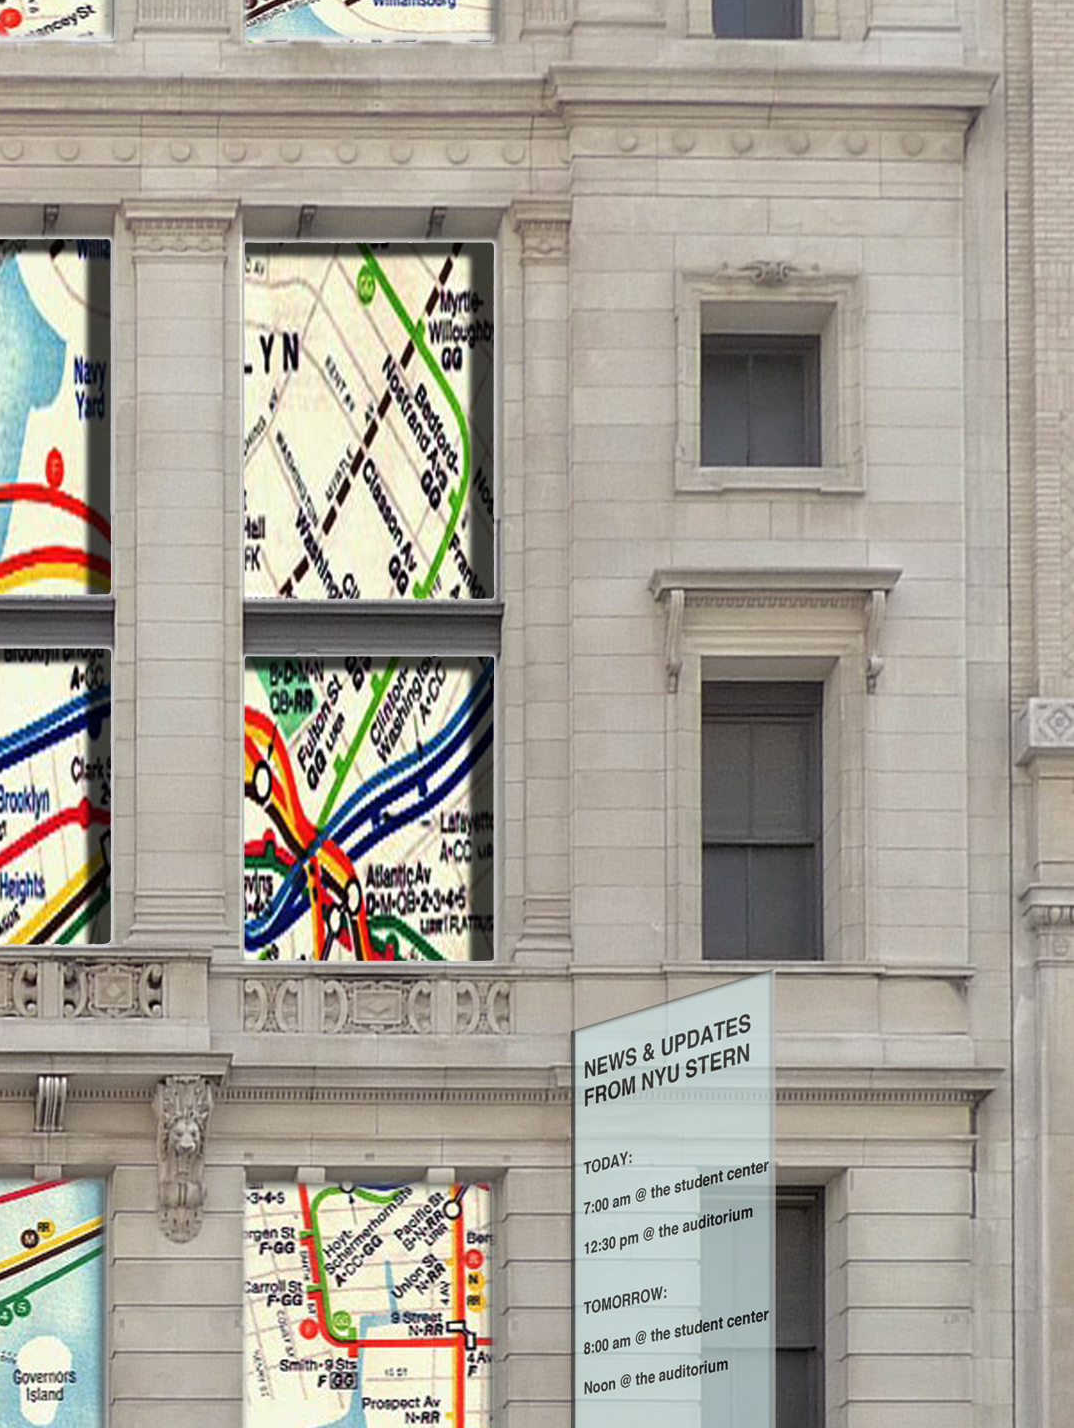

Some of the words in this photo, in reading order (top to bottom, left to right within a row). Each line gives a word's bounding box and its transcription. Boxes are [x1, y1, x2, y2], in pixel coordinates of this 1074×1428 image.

[74, 358, 106, 391] Navy
[75, 393, 105, 420] Yard
[0, 871, 46, 905] Heights
[366, 864, 414, 889] Atlantic
[584, 1048, 637, 1079] NEWS
[642, 1043, 655, 1062] &
[661, 1014, 751, 1056] UPDATES
[584, 1076, 636, 1107] FROM
[642, 1064, 680, 1091] NYU
[685, 1043, 750, 1078] STERN
[584, 1151, 632, 1174] TODAY:
[584, 1197, 609, 1214] 7:00
[612, 1194, 631, 1208] am
[635, 1188, 647, 1202] @
[651, 1184, 671, 1199] the
[674, 1171, 723, 1193] student
[727, 1160, 769, 1180] center
[584, 1236, 616, 1254] 12:30
[620, 1233, 639, 1250] pm
[643, 1227, 655, 1241] @
[658, 1222, 679, 1238] the
[682, 1205, 753, 1232] auditorium
[392, 1264, 425, 1299] Union
[584, 1286, 668, 1314] TOMORROW:
[403, 1312, 443, 1324] Street
[584, 1338, 609, 1355] 8:00
[612, 1336, 631, 1350] am
[635, 1330, 647, 1345] @
[651, 1327, 671, 1342] the
[674, 1317, 723, 1338] student
[727, 1309, 769, 1328] center
[13, 1369, 76, 1386] Governors
[584, 1379, 616, 1395] Noon
[620, 1374, 632, 1388] @
[636, 1370, 655, 1386] the
[659, 1358, 728, 1382] auditorium
[26, 1387, 65, 1402] Island
[362, 1397, 420, 1410] Prospect
[423, 1397, 441, 1408] Av
